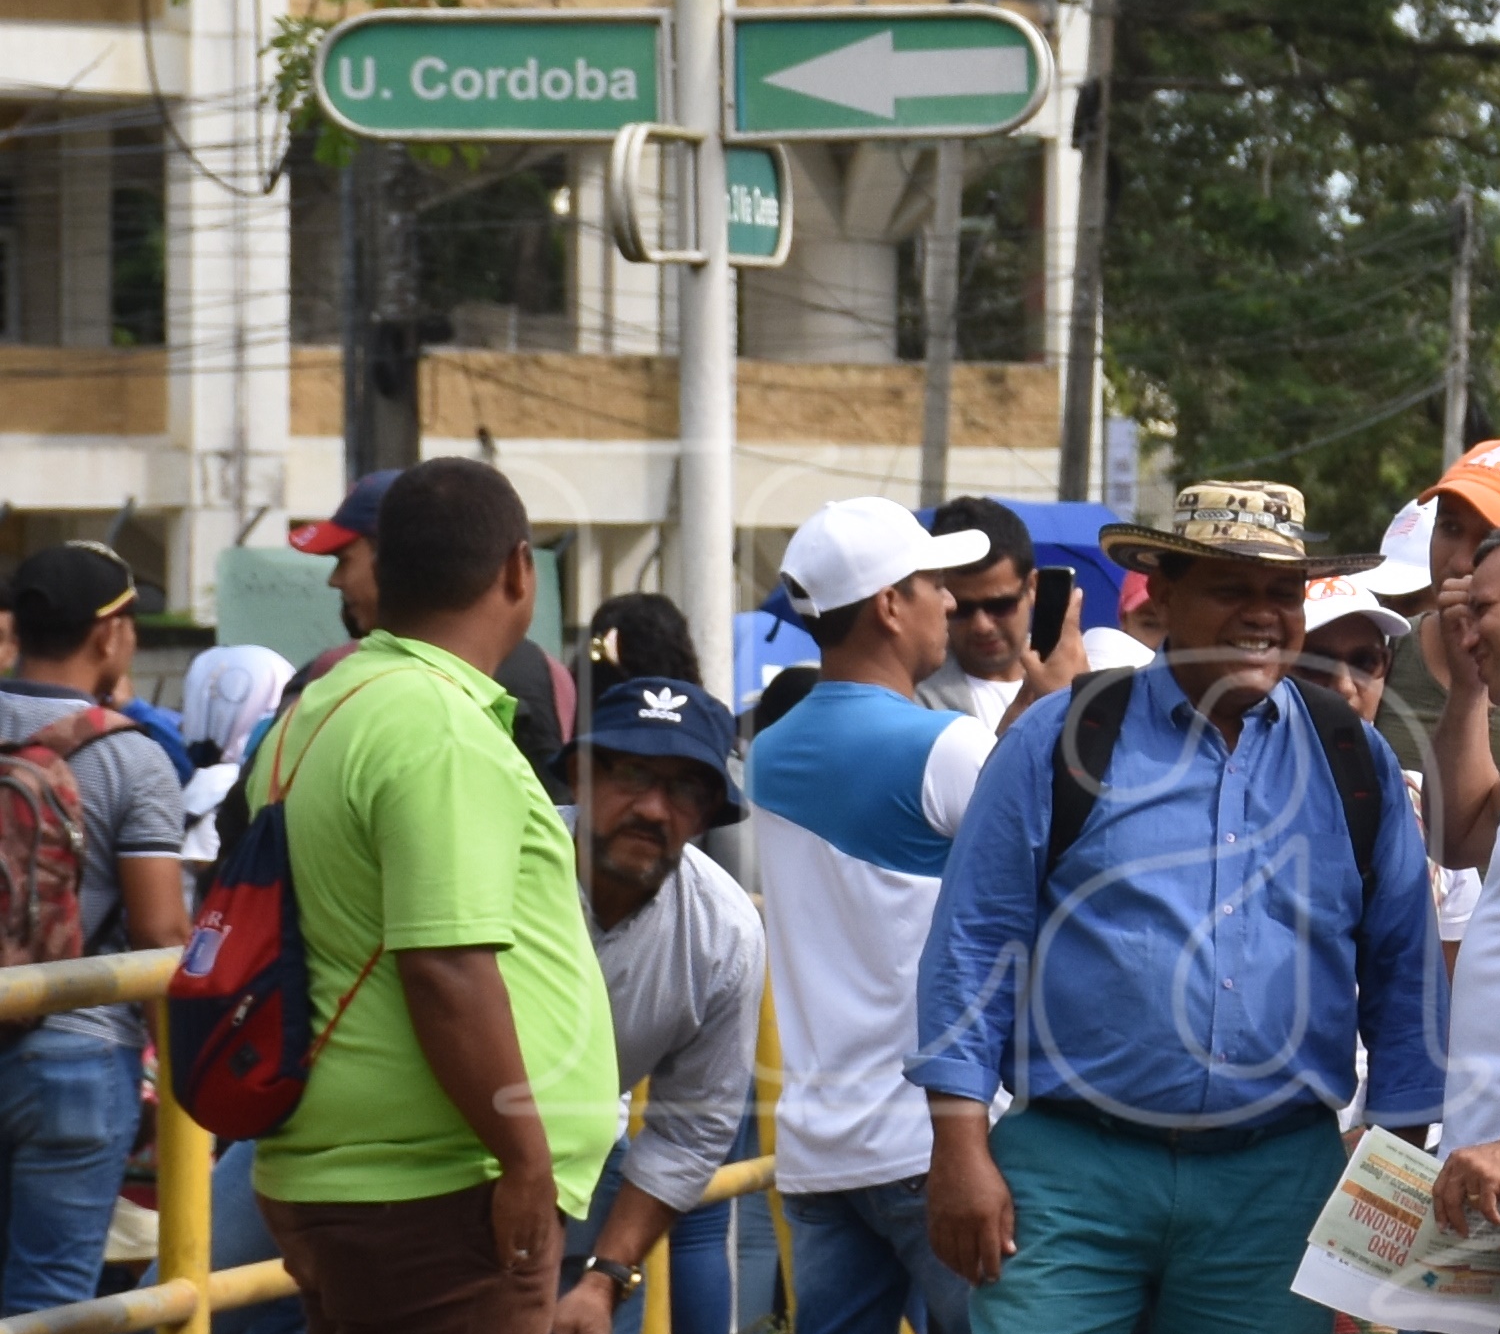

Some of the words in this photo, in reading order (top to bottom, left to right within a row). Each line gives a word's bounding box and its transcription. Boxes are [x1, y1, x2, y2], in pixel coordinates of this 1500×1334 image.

[338, 60, 391, 101] U.
[410, 57, 638, 104] Cordoba
[638, 708, 682, 723] adidas
[1345, 1196, 1419, 1249] NACIONAL
[1365, 1232, 1410, 1268] PARO
